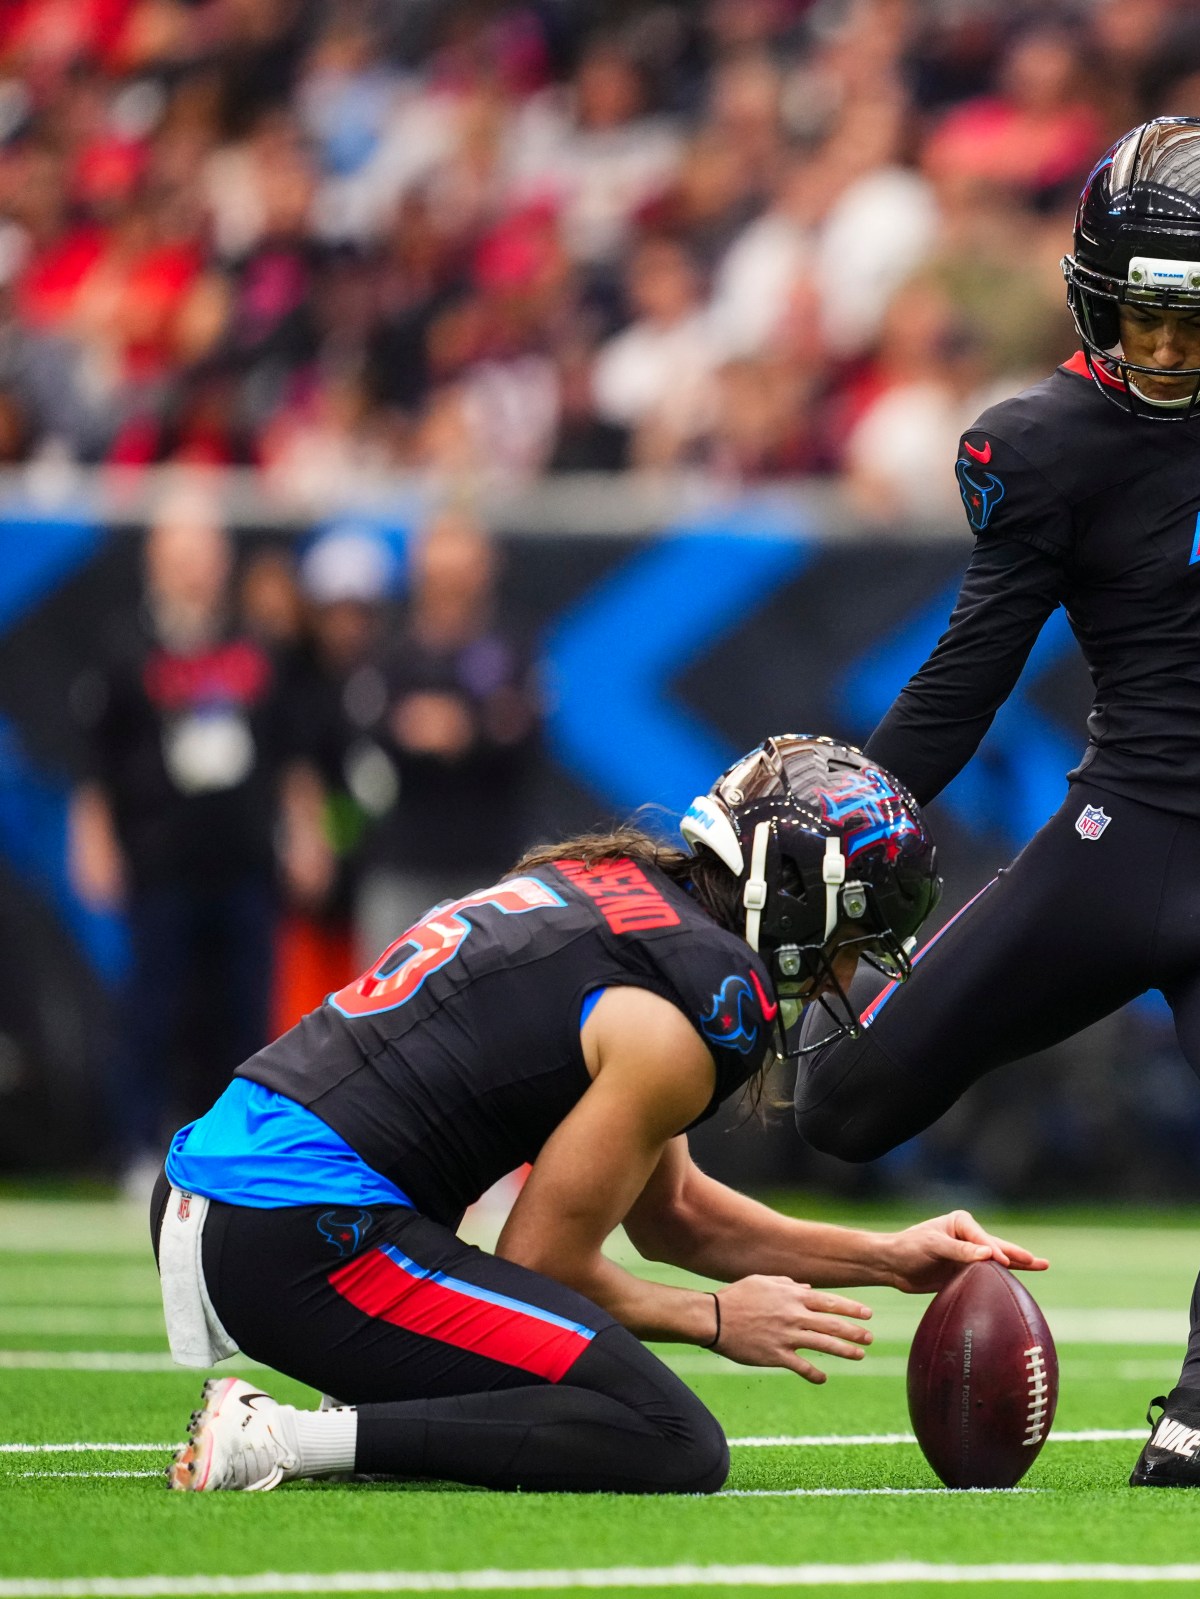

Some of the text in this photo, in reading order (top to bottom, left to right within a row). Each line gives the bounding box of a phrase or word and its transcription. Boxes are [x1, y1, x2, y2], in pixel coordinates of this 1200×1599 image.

[1080, 817, 1100, 836] NFL
[328, 876, 569, 1018] 6
[963, 1328, 973, 1380] NATIONAL
